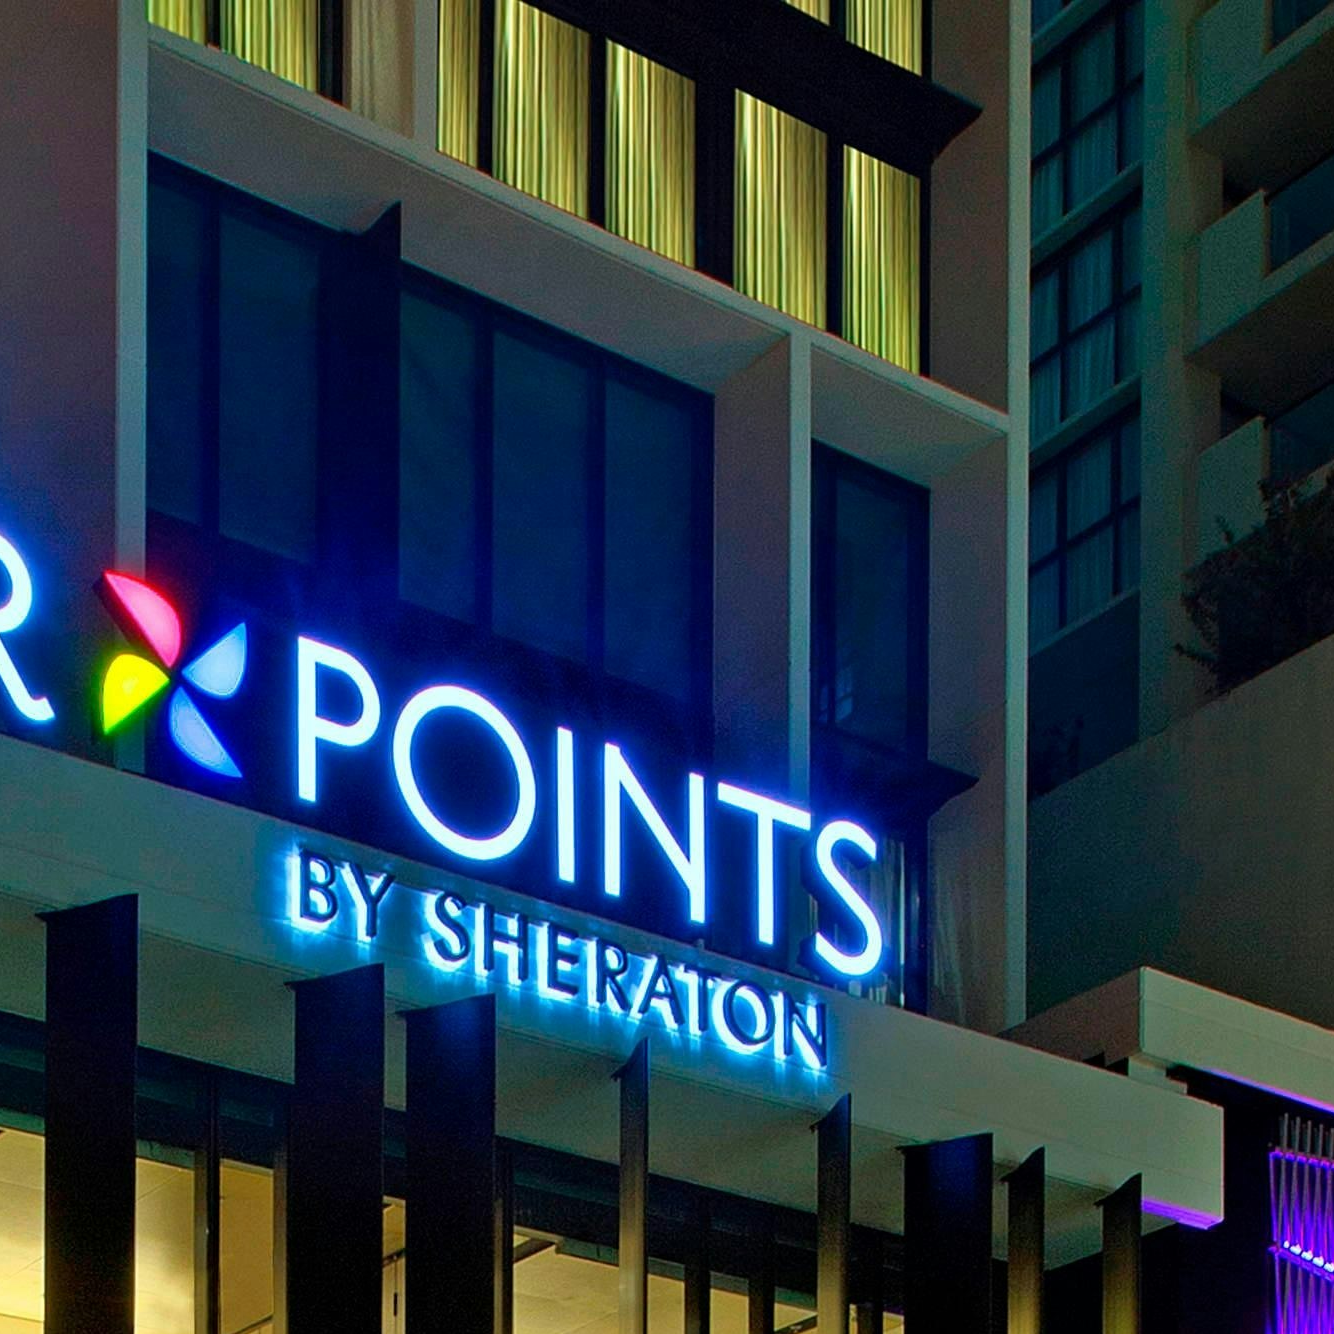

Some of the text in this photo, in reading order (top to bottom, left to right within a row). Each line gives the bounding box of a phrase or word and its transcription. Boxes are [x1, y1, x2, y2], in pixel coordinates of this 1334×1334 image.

[296, 635, 884, 976] POINTS
[289, 846, 828, 1073] BY SHERATON
